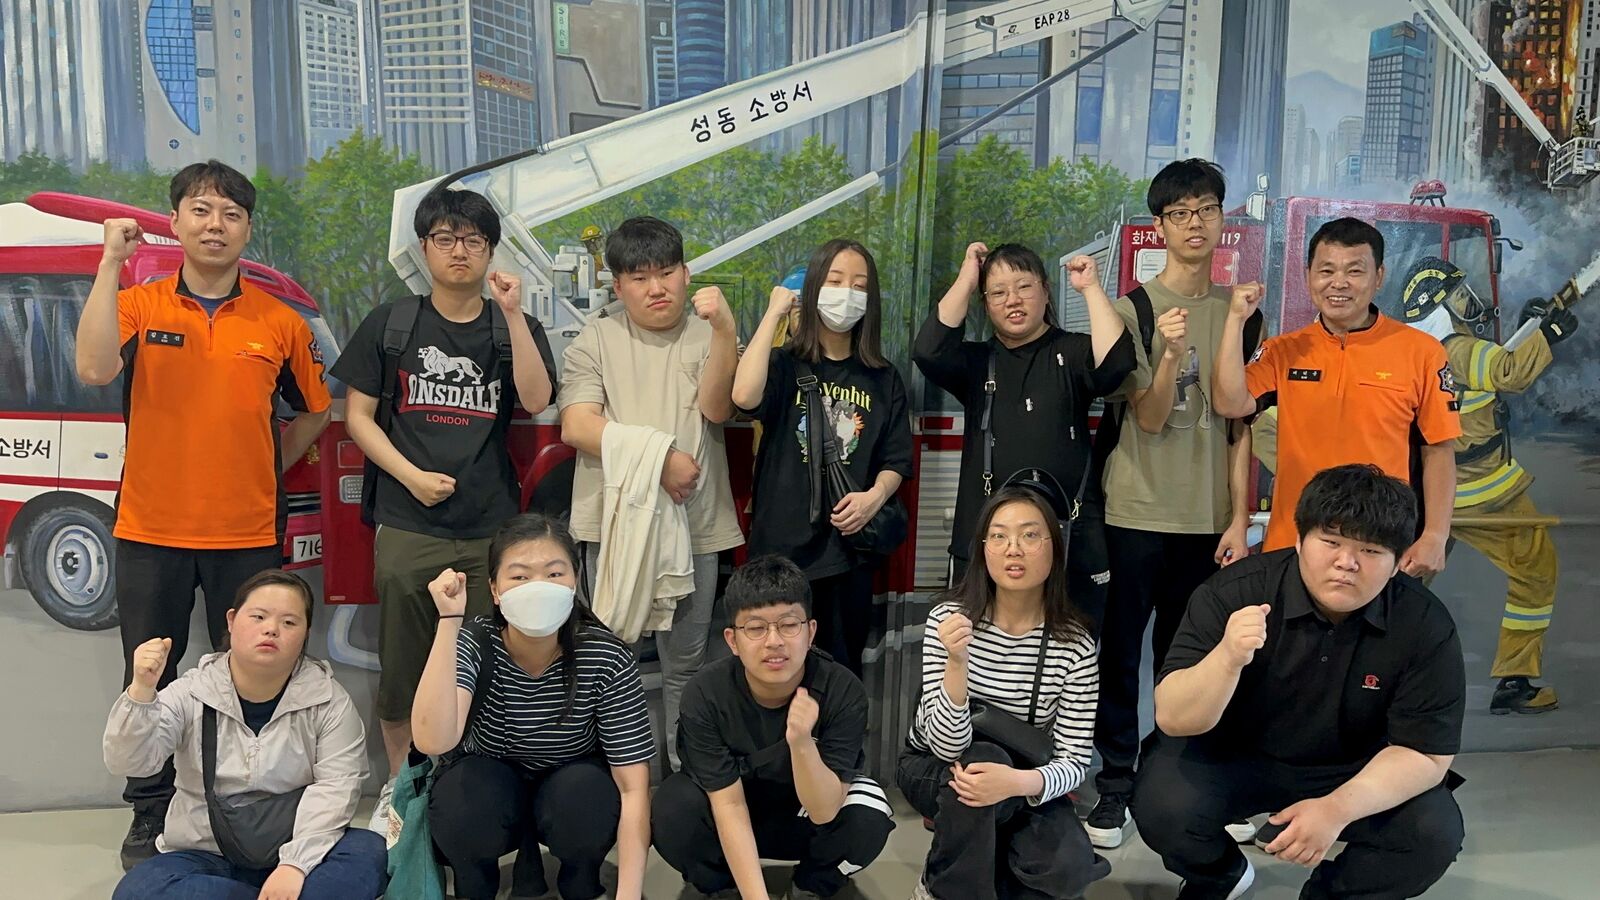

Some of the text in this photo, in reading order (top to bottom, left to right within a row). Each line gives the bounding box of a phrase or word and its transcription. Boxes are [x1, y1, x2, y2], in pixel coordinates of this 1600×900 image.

[1034, 9, 1070, 30] EAP 28
[690, 80, 813, 143] 성동 소방서
[426, 413, 470, 426] LONDON
